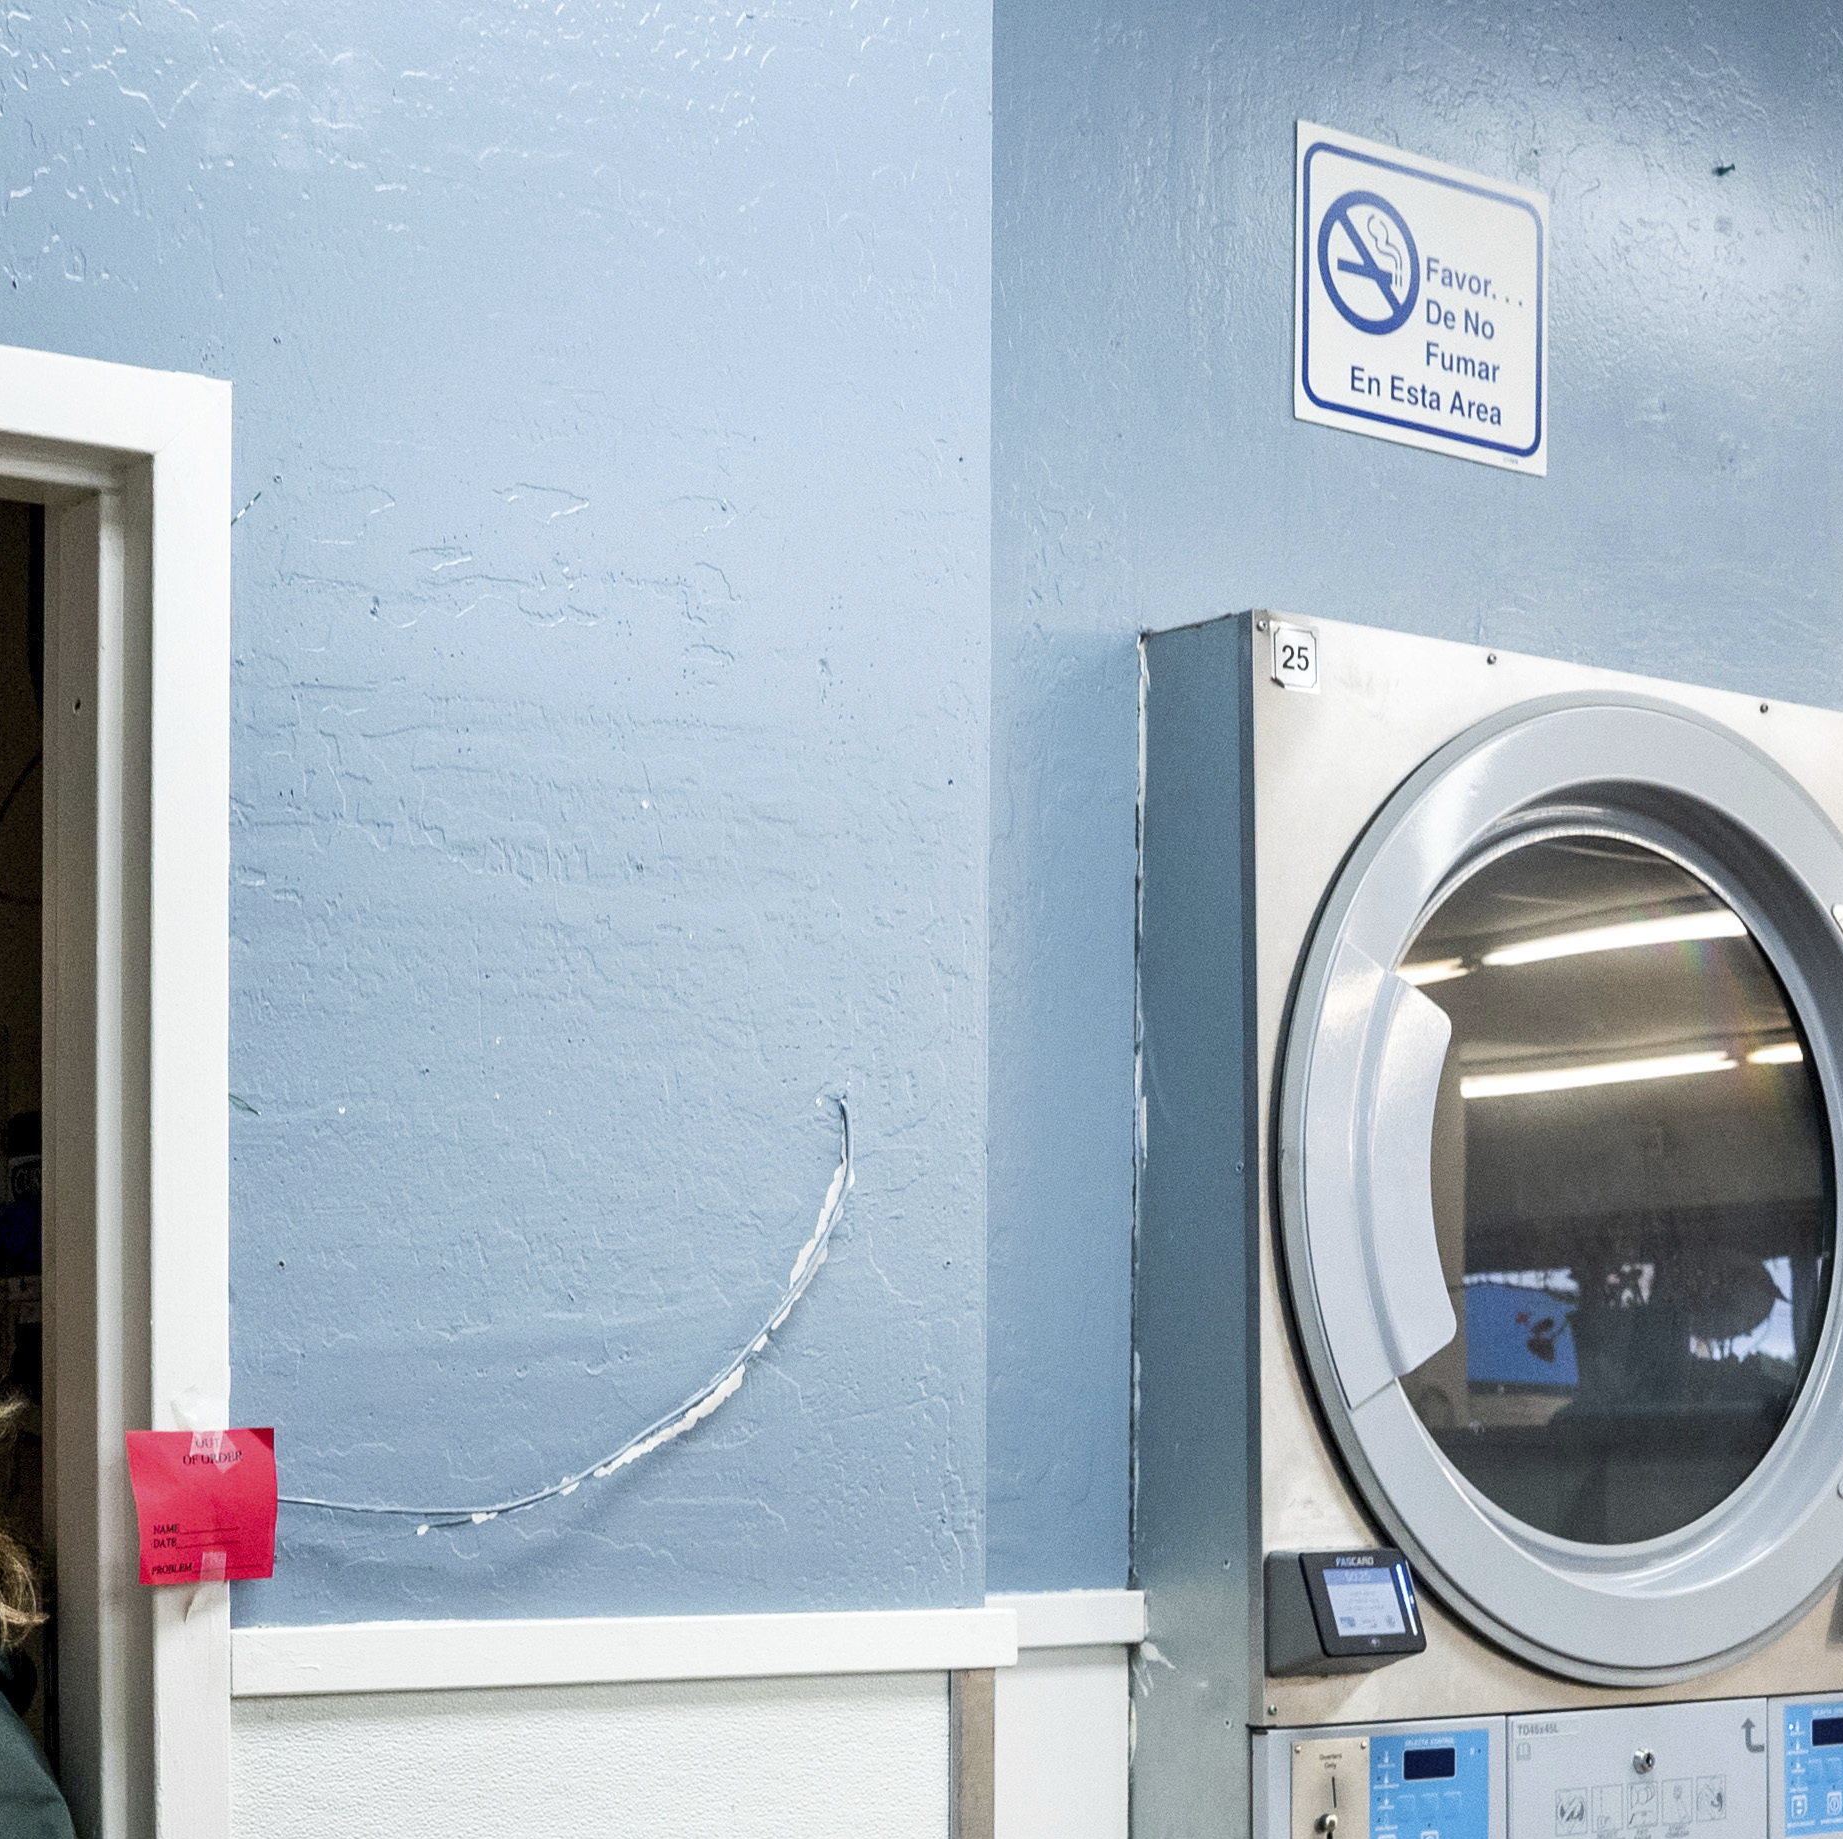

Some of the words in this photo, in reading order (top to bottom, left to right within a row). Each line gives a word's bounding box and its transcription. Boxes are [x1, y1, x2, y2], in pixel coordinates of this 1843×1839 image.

[1426, 299, 1456, 331] De
[1463, 308, 1496, 341] No
[1426, 341, 1501, 384] Fumar
[1350, 365, 1381, 397] En
[1390, 376, 1441, 412] Esta
[1449, 389, 1502, 427] Area
[1282, 644, 1310, 672] 25
[195, 1437, 220, 1449] OUT
[183, 1454, 199, 1466] OF
[201, 1450, 243, 1465] ORDER
[153, 1523, 179, 1535] NAME
[153, 1537, 177, 1549] DATE
[151, 1562, 192, 1576] PROBLEM
